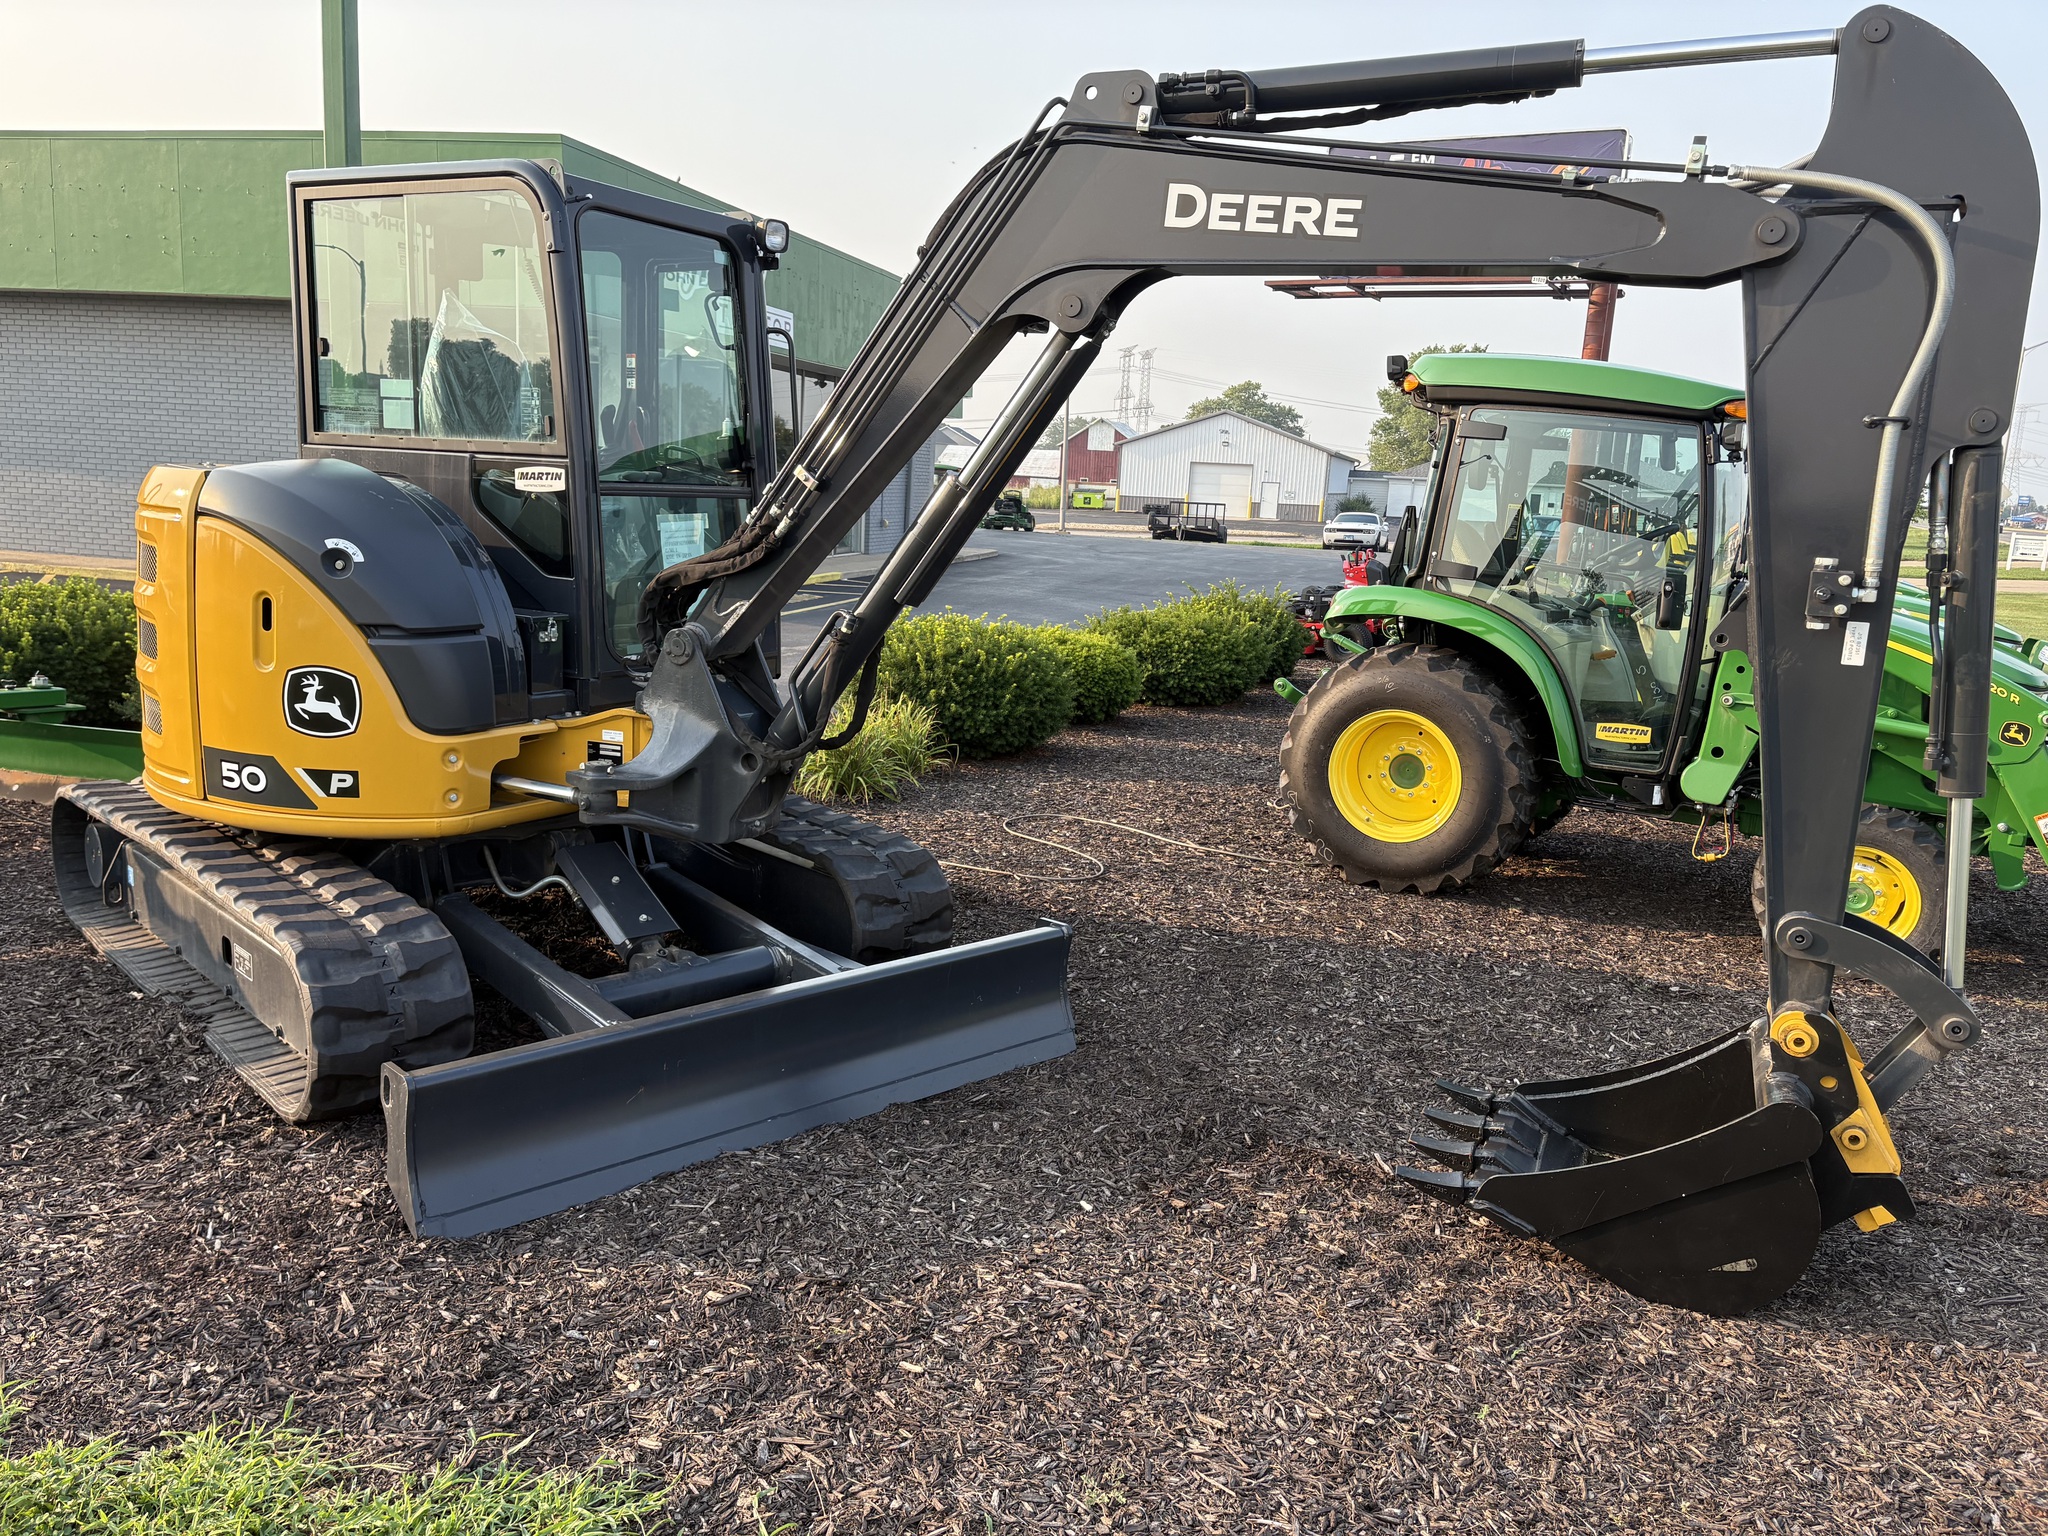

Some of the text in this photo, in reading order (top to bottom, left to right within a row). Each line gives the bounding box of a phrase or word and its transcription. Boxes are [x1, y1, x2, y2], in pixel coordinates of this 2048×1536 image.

[1163, 182, 1363, 238] DEERE
[517, 471, 563, 481] MARTIN
[1599, 726, 1649, 736] MARTIN
[221, 761, 354, 795] 50 P
